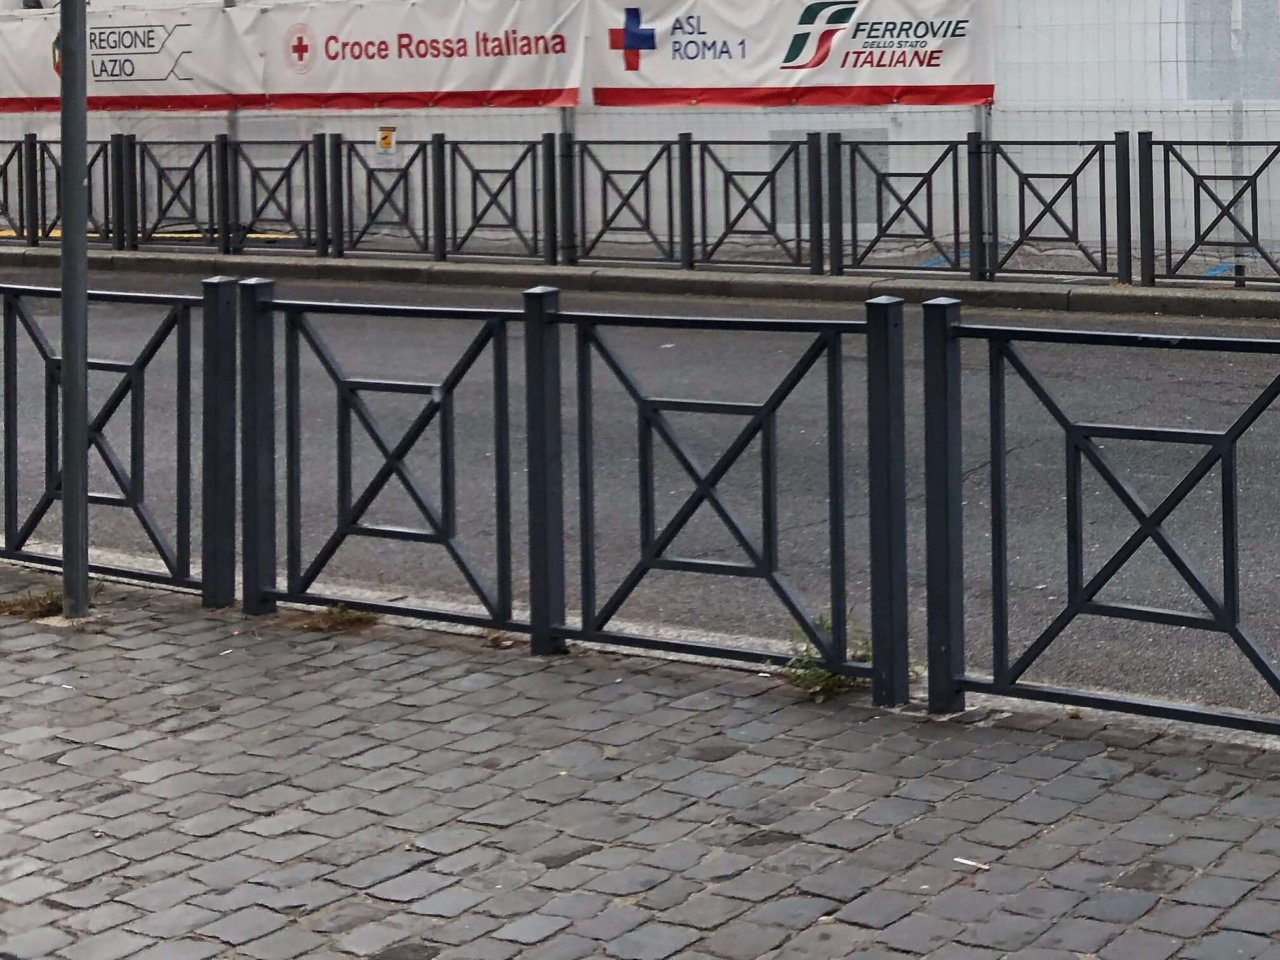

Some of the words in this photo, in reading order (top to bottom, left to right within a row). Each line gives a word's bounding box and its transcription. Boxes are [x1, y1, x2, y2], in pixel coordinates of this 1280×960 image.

[670, 15, 707, 36] ASL
[851, 20, 969, 39] FERROVIE
[89, 30, 156, 50] REGIONE
[324, 35, 389, 61] Croce
[397, 33, 468, 59] Rossa
[475, 30, 567, 57] Italiana
[672, 40, 732, 60] ROMA
[738, 38, 746, 59] 1
[862, 40, 894, 49] DELLO
[896, 40, 928, 49] STATO
[91, 58, 135, 77] LAZIO
[840, 50, 944, 68] ITALIANE
